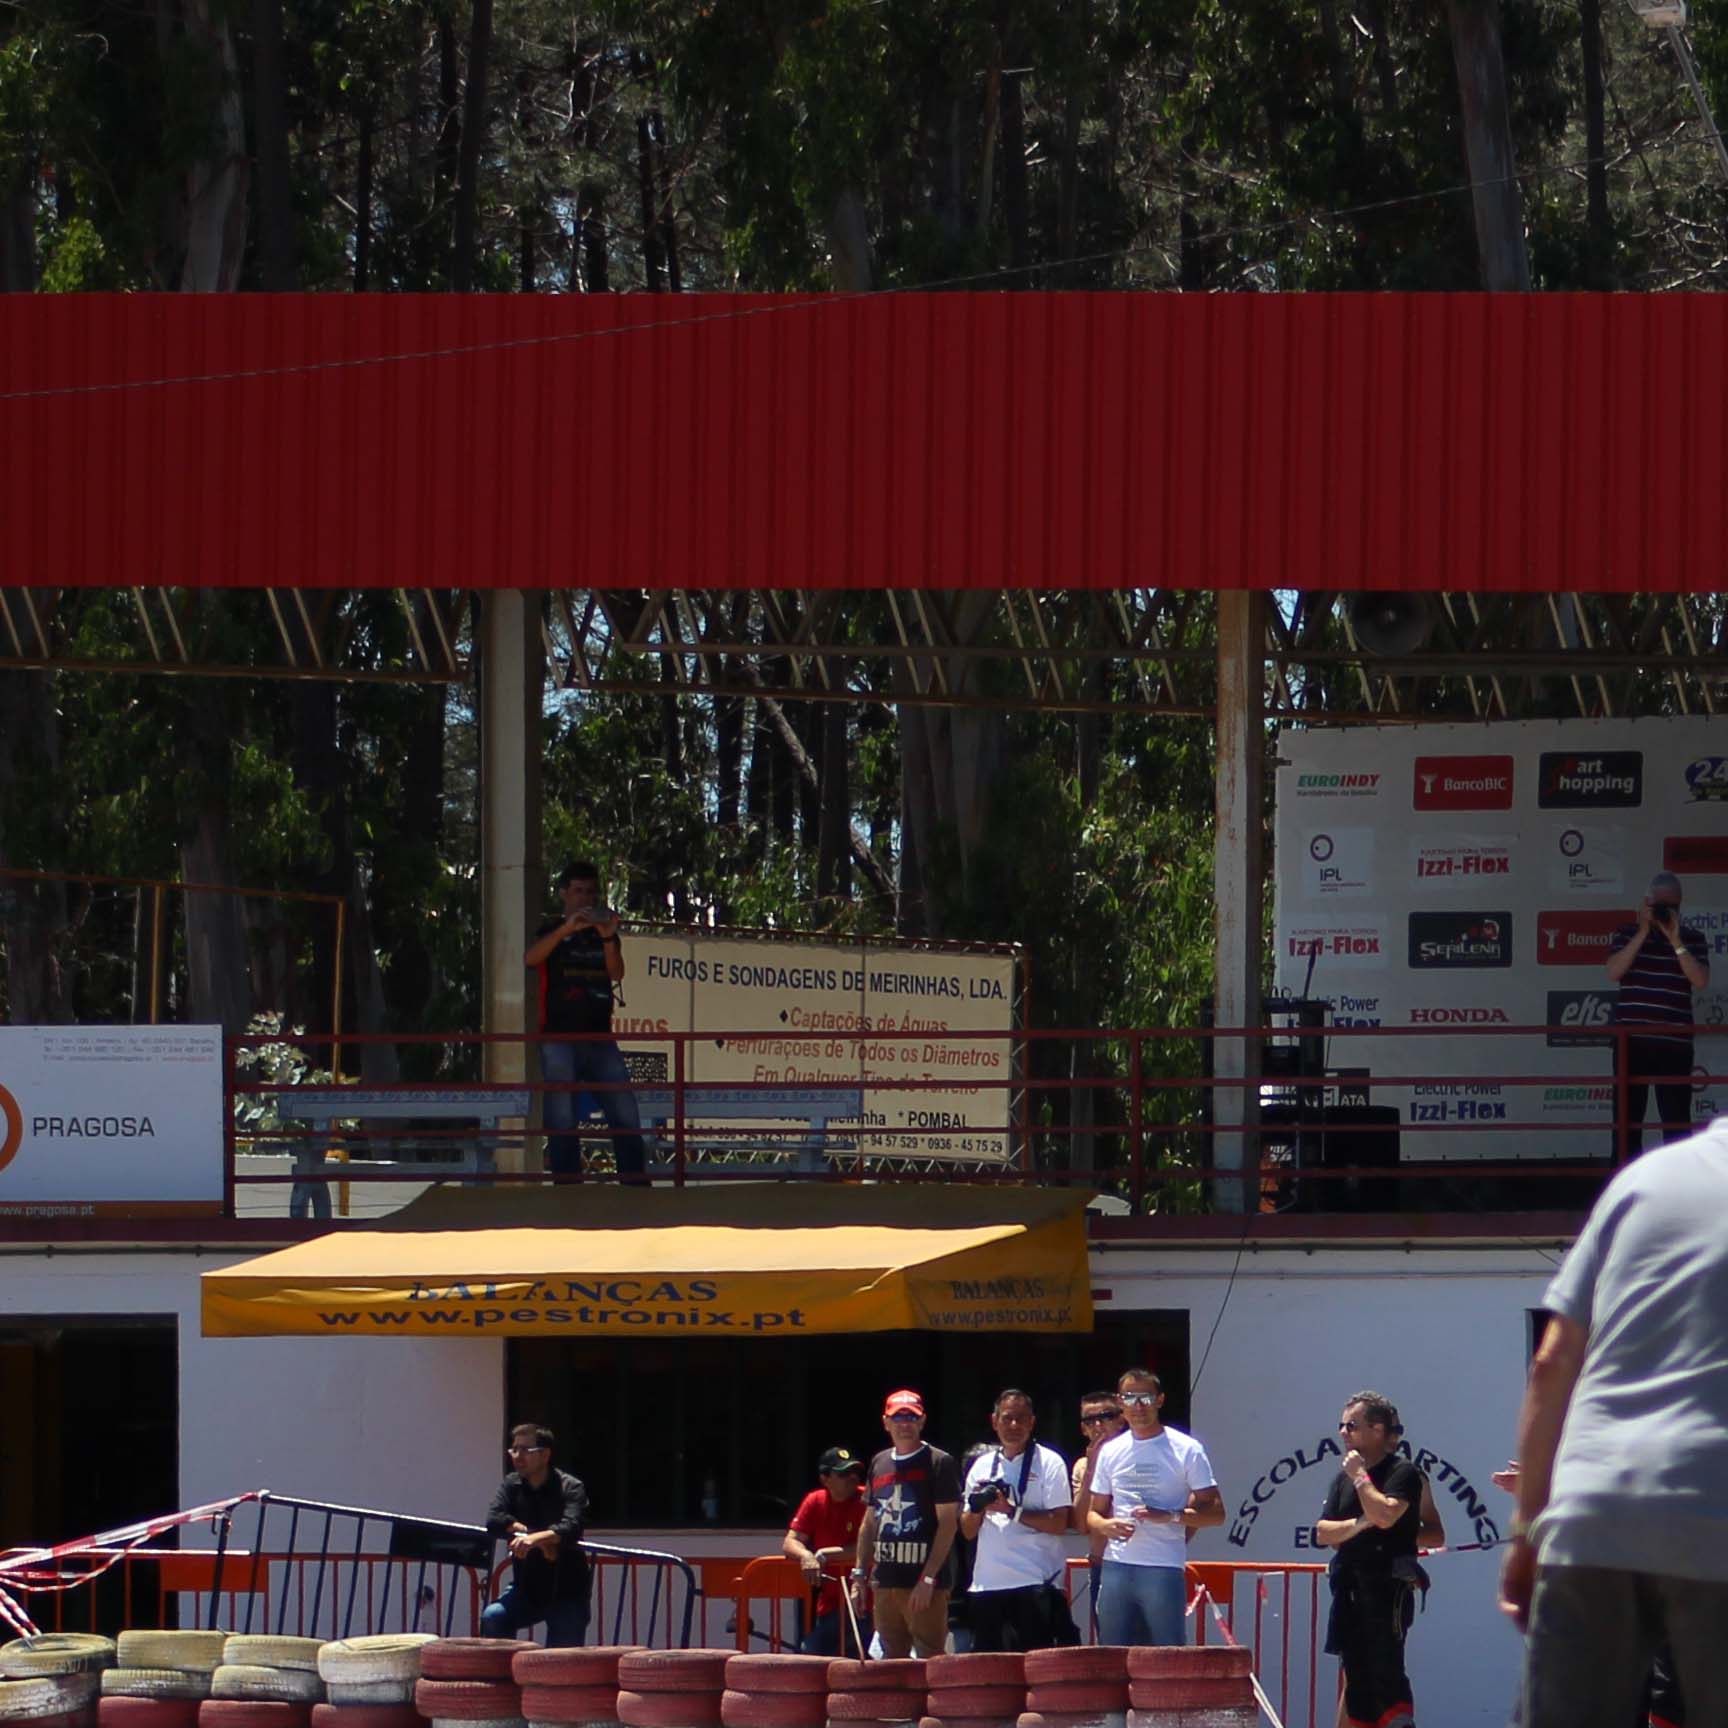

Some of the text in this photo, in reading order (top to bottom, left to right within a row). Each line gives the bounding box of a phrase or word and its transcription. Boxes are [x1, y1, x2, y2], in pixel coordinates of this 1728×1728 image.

[1298, 773, 1381, 788] EUROINDY
[1443, 776, 1508, 793] BancoBIC
[1319, 867, 1343, 882] IPL
[1417, 856, 1510, 878] Izzi-Flex
[1569, 863, 1593, 878] IPL
[1680, 914, 1716, 929] lectric
[1567, 932, 1614, 947] Banco
[648, 956, 1008, 1001] FUROS E SONDAGENS DE MEIRINHAS, LDA.
[1340, 995, 1380, 1013] Power
[790, 1007, 873, 1032] Captações
[877, 1013, 896, 1032] de
[1410, 1008, 1510, 1024] HONDA
[824, 1039, 844, 1058] de
[850, 1040, 895, 1062] Todos
[900, 1047, 919, 1062] os
[922, 1044, 1000, 1067] Diâmetros
[753, 1065, 779, 1083] Em
[1410, 1100, 1507, 1122] Izzi-Flex
[32, 1116, 156, 1138] PRAGOSA
[317, 1307, 807, 1331] www.pestronix.pt
[1227, 1437, 1500, 1551] ESCOLA ARTING
